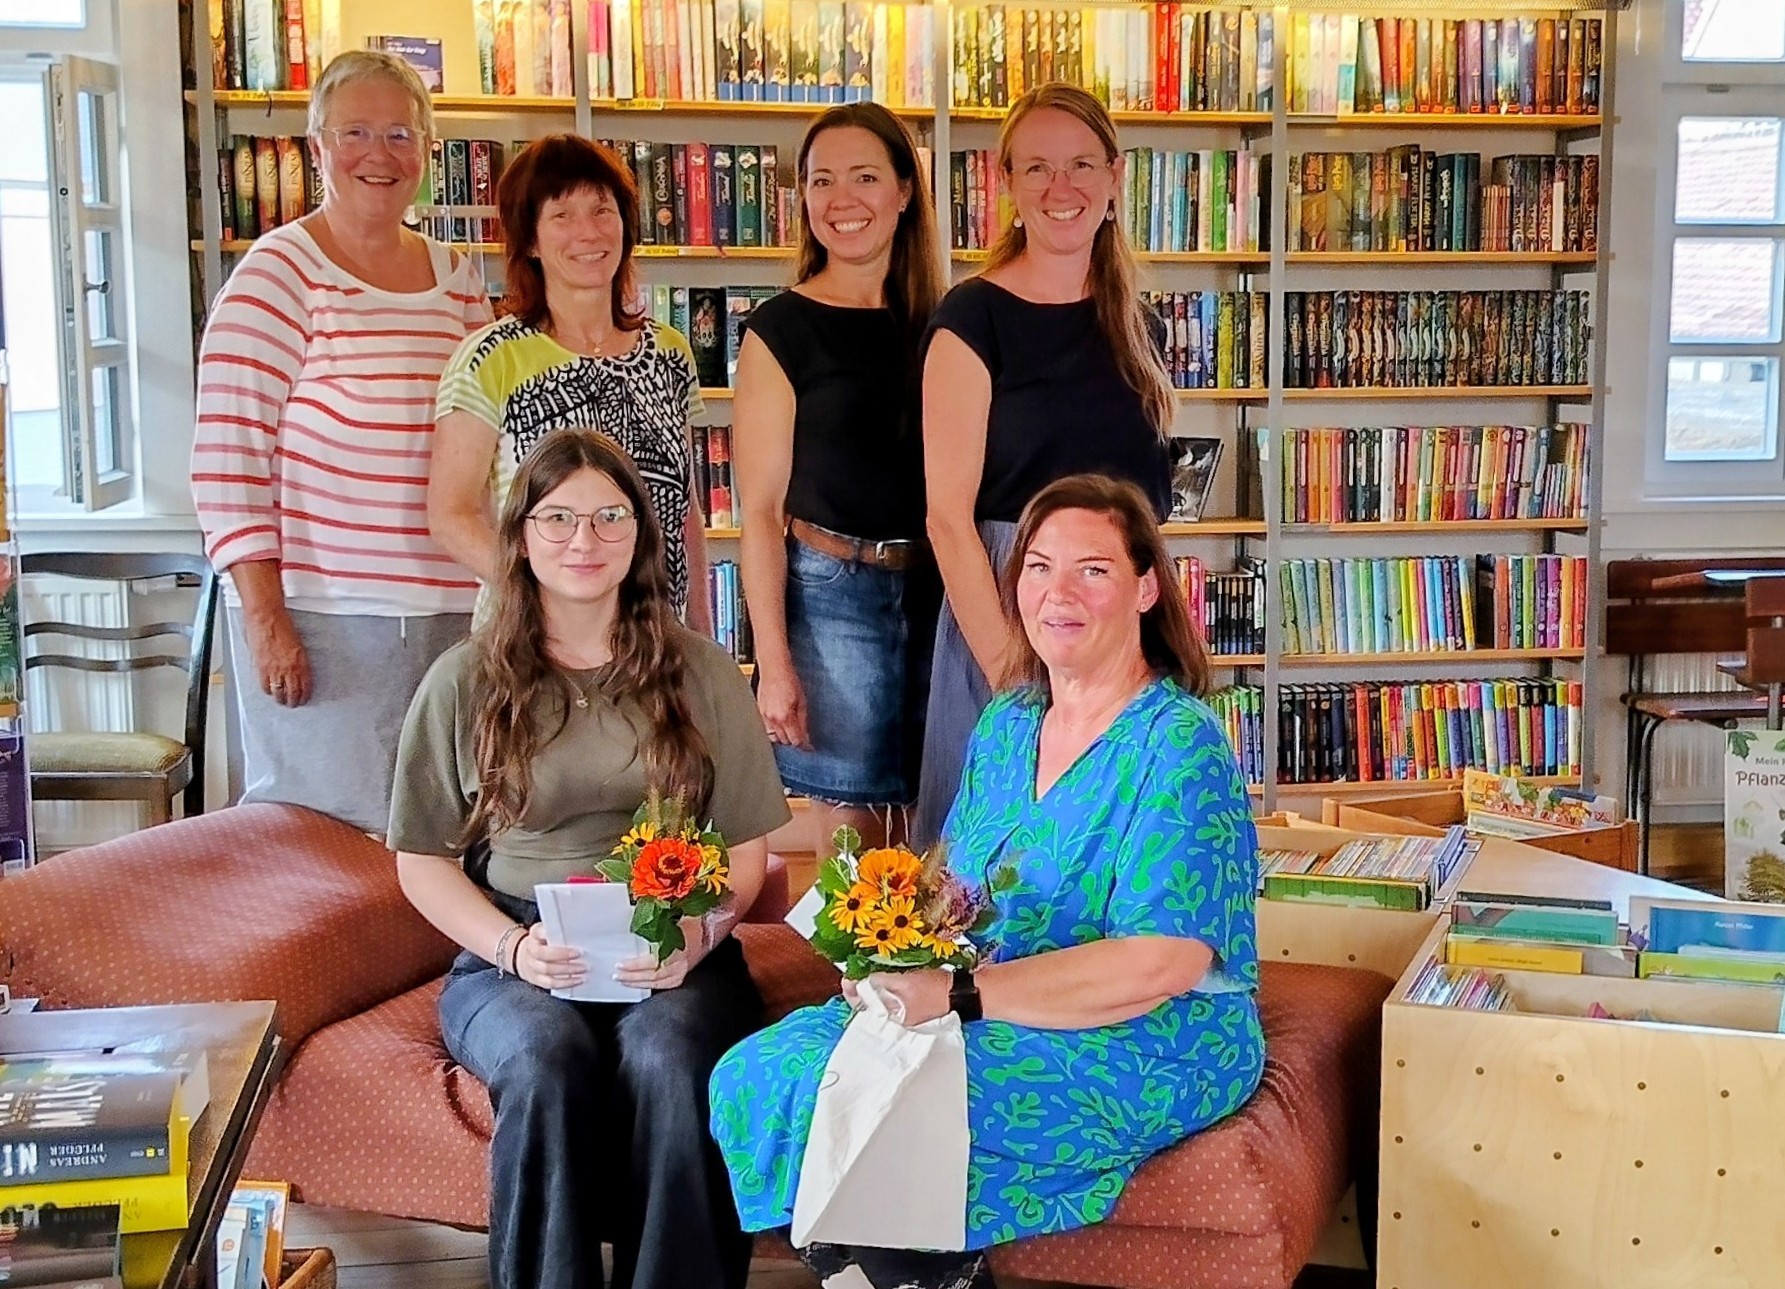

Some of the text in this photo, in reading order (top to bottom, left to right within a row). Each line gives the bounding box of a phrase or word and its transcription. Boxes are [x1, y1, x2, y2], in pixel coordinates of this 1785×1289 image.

[1755, 757, 1779, 765] Mein
[1735, 770, 1785, 786] Pflanz
[49, 1153, 107, 1167] ANDREAS
